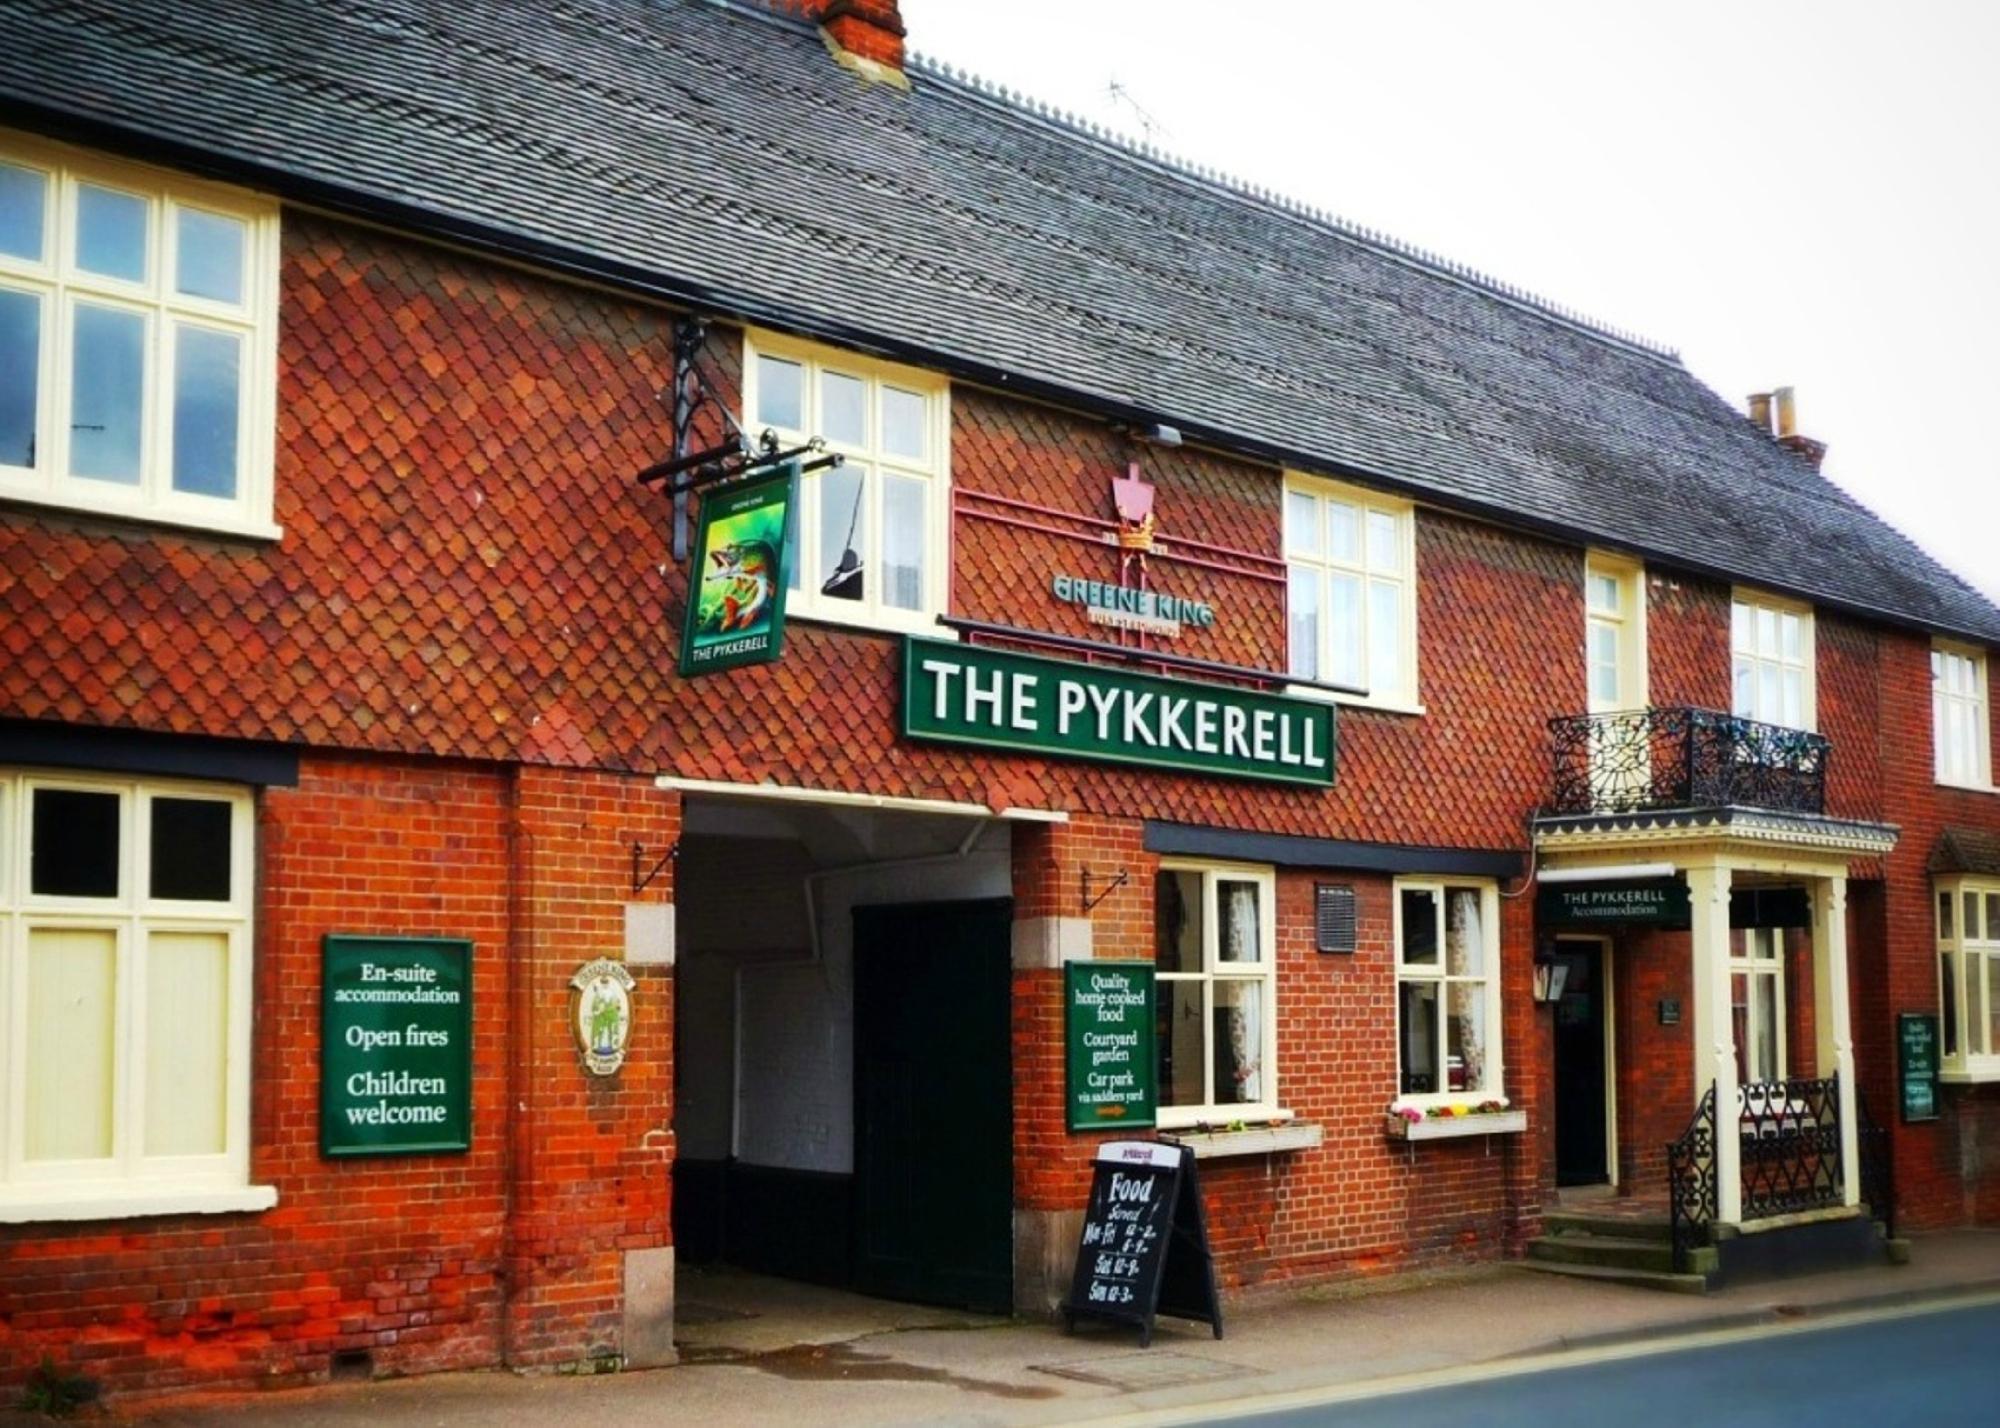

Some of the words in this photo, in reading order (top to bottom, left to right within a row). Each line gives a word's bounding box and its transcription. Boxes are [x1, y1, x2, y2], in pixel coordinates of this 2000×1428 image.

[1053, 574, 1148, 615] GREENE
[1155, 594, 1214, 627] KING
[693, 647, 713, 661] THE
[713, 635, 768, 658] PYKKERELL
[922, 659, 1038, 731] THE
[1058, 680, 1326, 768] PYKKERELL
[1562, 892, 1588, 904] THE
[1592, 889, 1666, 903] PYKKERELL
[1571, 903, 1657, 917] Accommodation
[360, 963, 437, 983] En-suite
[1091, 973, 1130, 992] Quality
[334, 985, 461, 1004] accommodation
[1075, 989, 1106, 1005] home
[1107, 989, 1145, 1005] cooked
[1098, 1004, 1124, 1022] food
[345, 1025, 400, 1051] Open
[405, 1024, 449, 1046] fires
[1083, 1031, 1138, 1049] Courtyard
[1093, 1046, 1129, 1066] garden
[346, 1070, 447, 1096] Children
[1087, 1072, 1106, 1087] Car
[1108, 1070, 1134, 1089] park
[346, 1100, 447, 1125] welcome
[1108, 1172, 1155, 1203] Food
